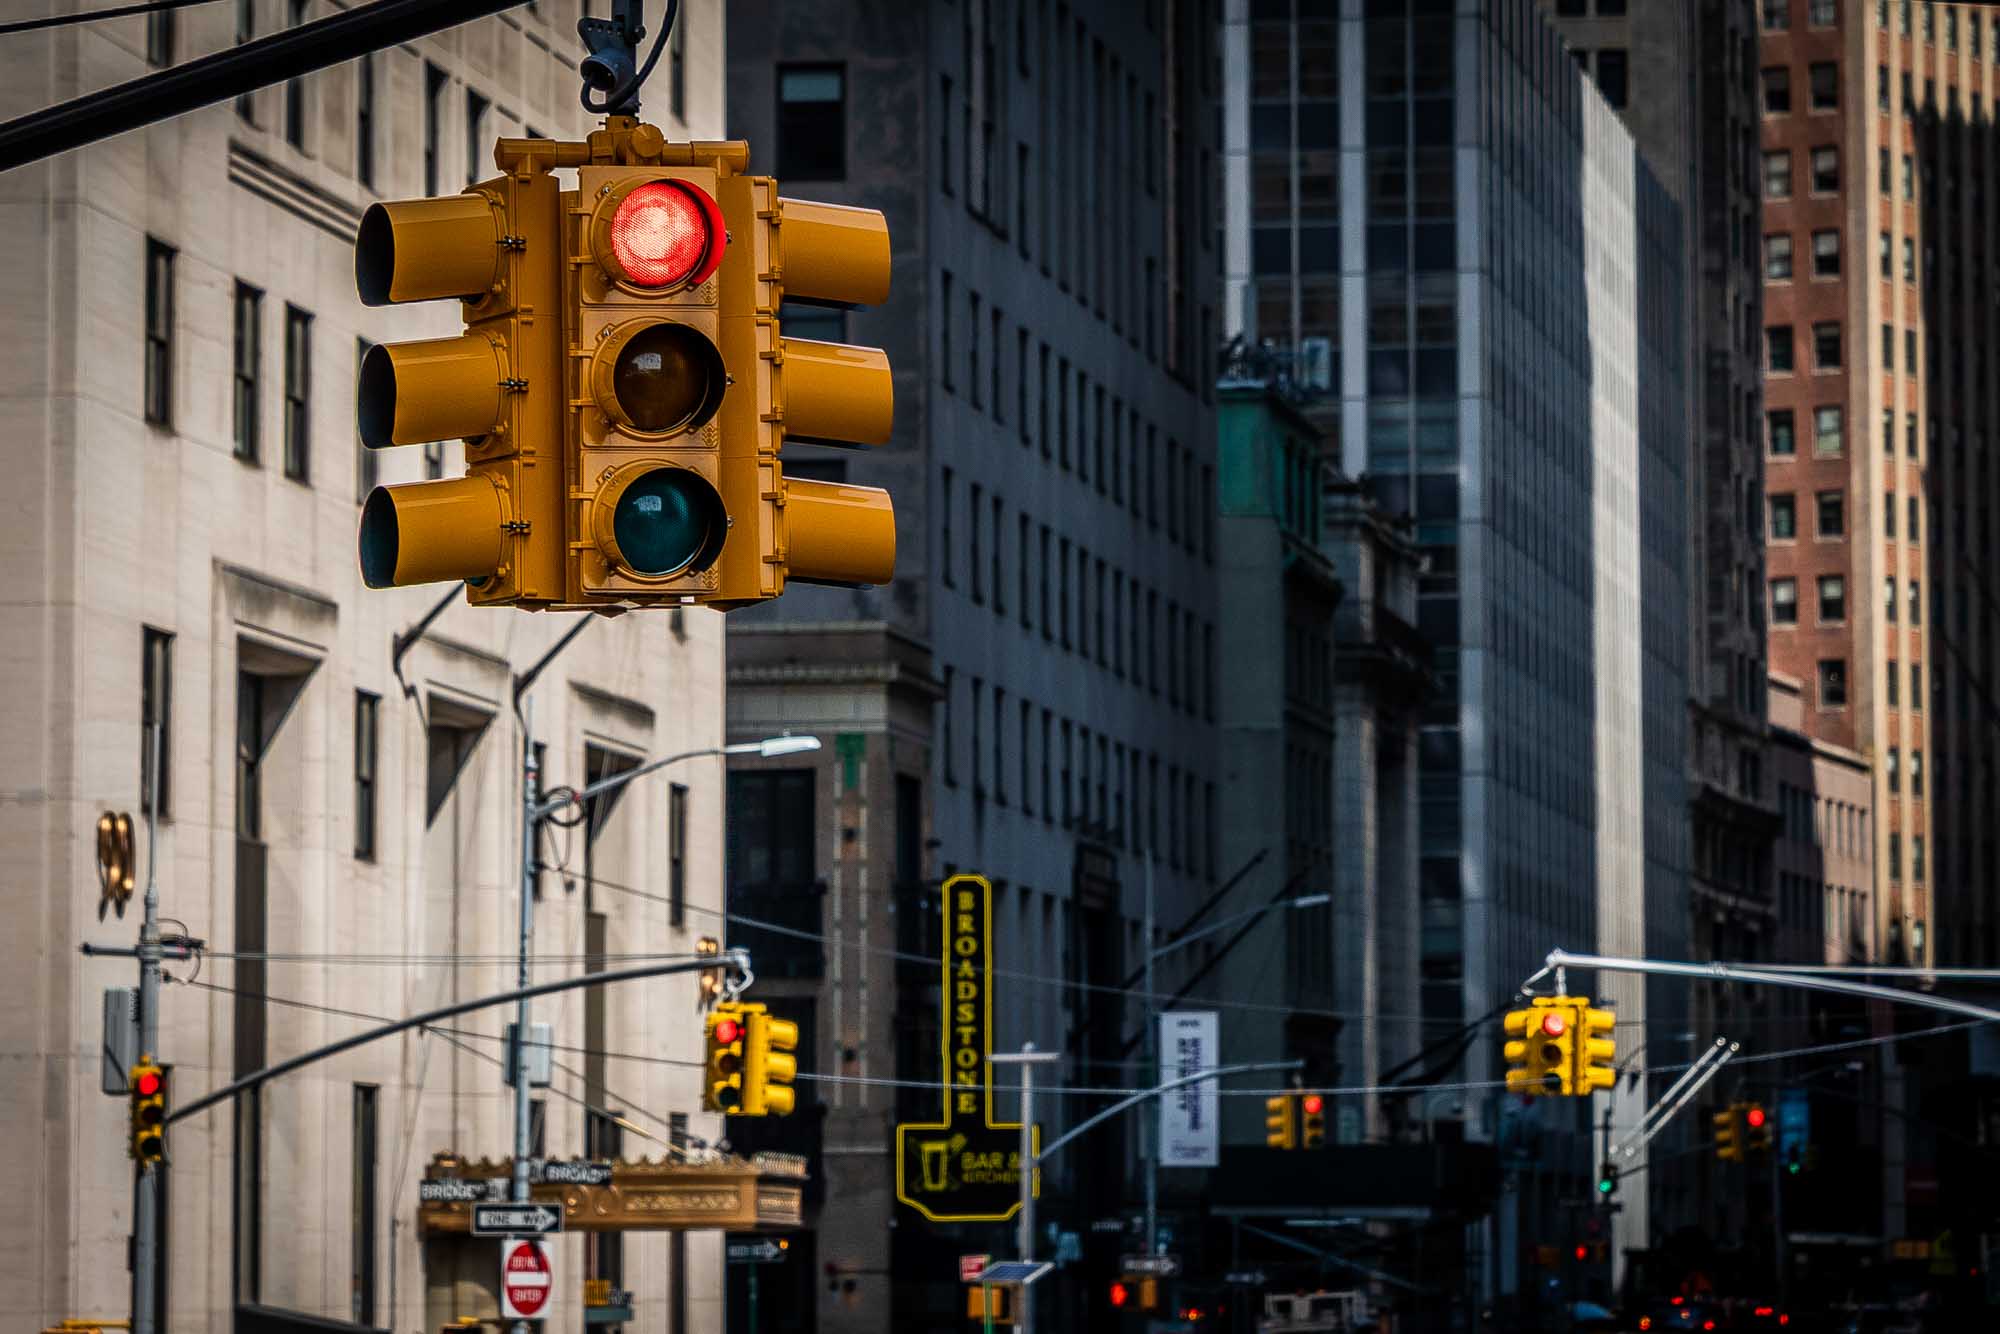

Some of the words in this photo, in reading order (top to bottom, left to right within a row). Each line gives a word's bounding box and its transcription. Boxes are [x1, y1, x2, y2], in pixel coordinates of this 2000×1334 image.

[954, 891, 979, 1114] BROADSTONE
[961, 1152, 1003, 1168] BAR
[422, 1184, 475, 1199] BRIDGE
[487, 1211, 510, 1225] ONE
[522, 1211, 548, 1226] WAY
